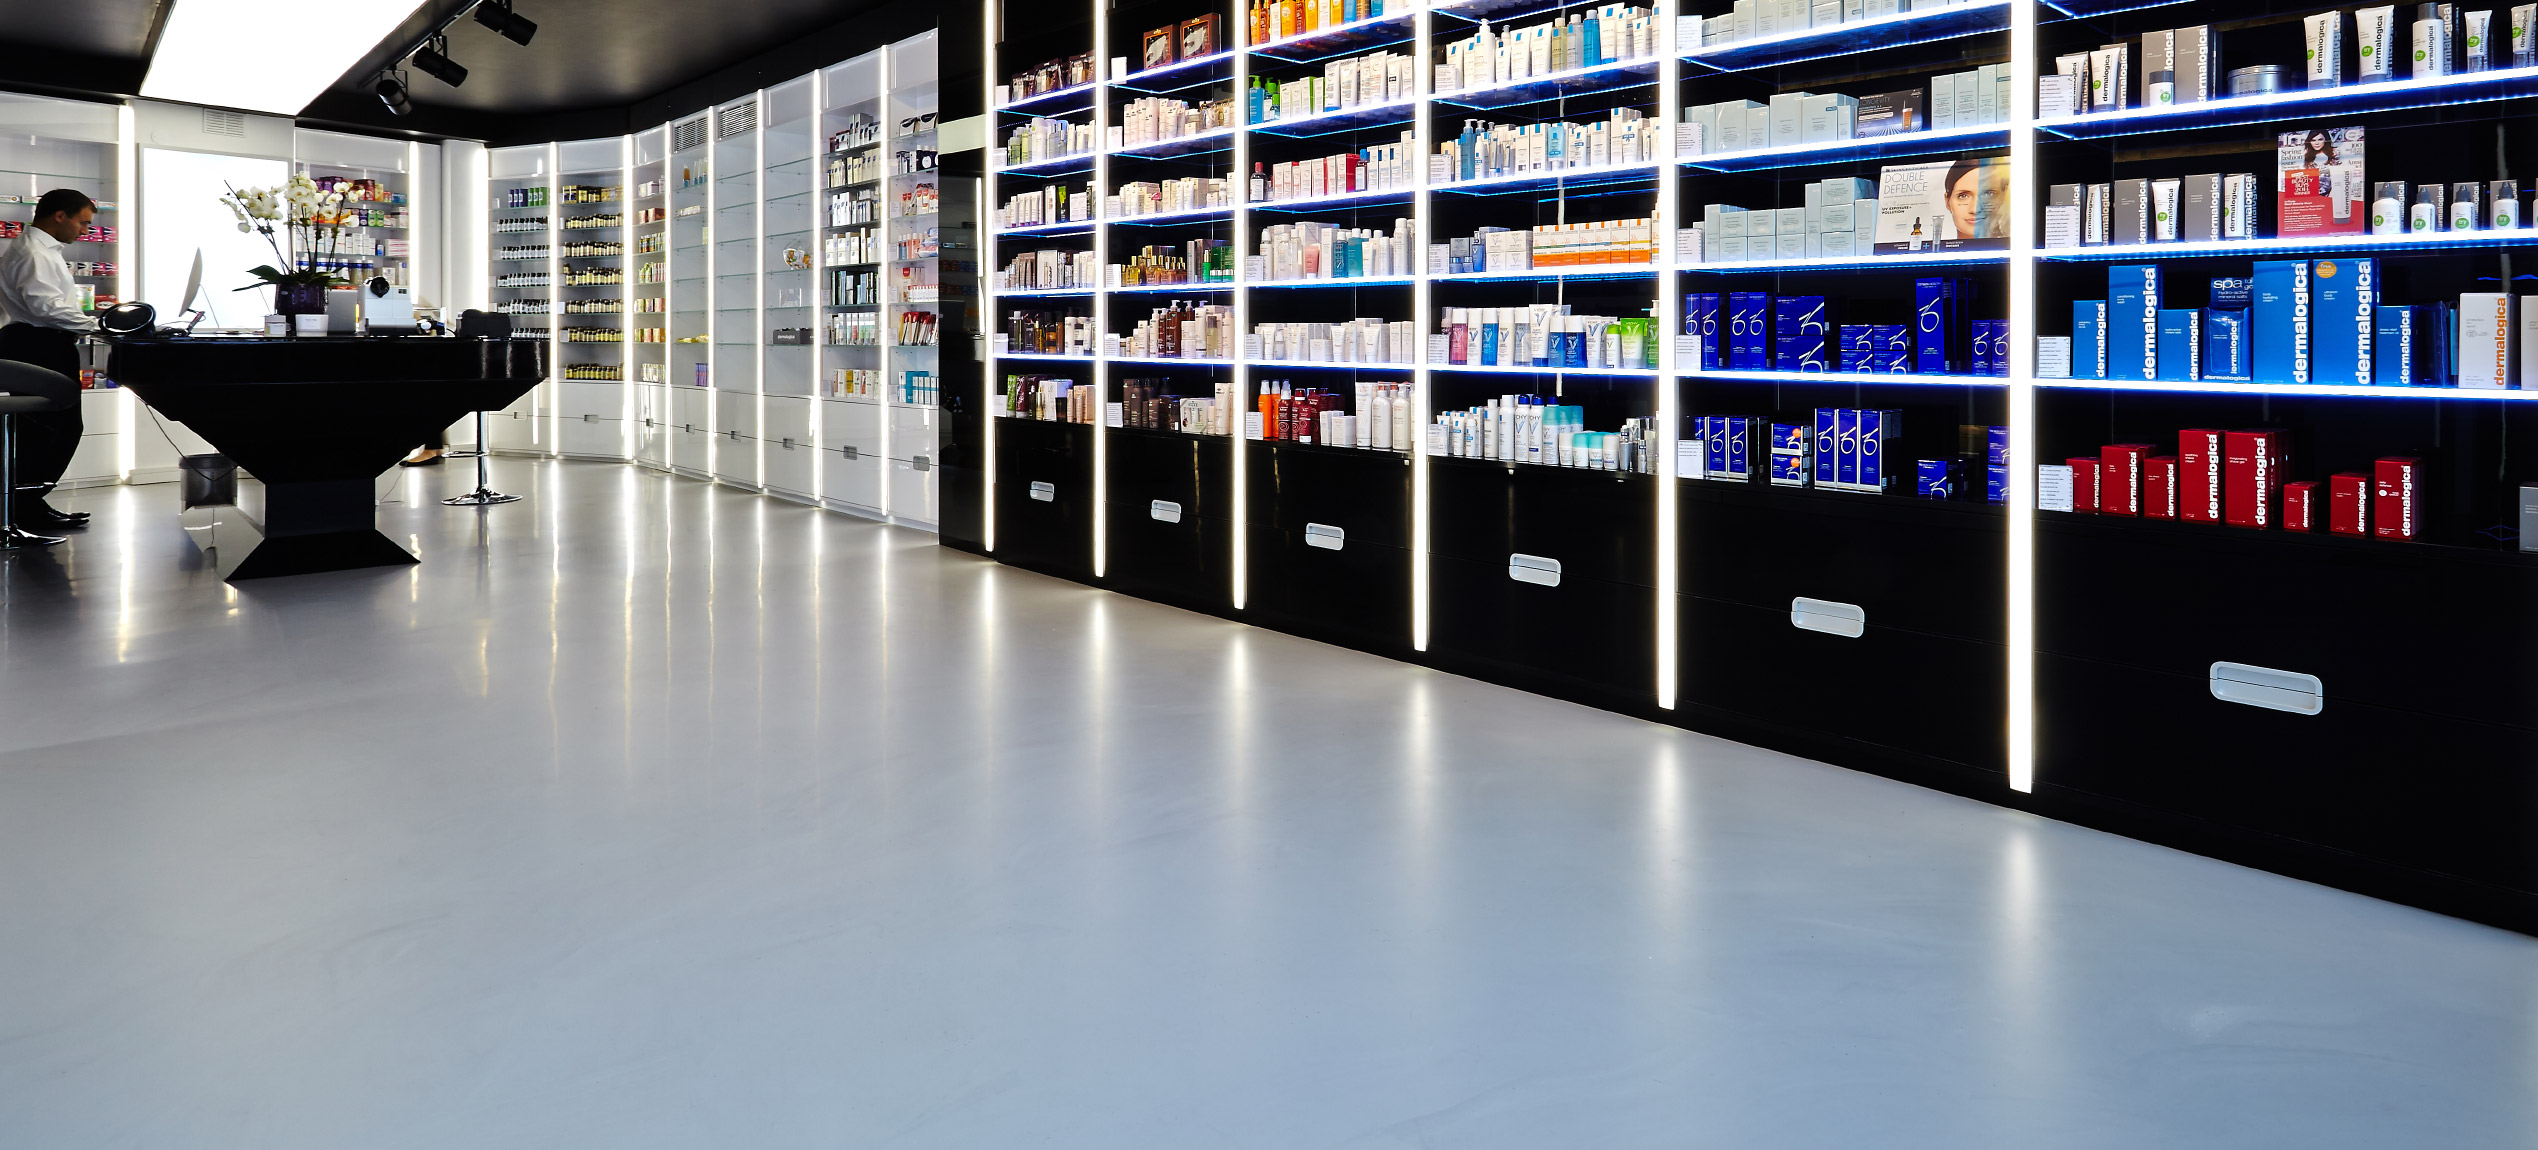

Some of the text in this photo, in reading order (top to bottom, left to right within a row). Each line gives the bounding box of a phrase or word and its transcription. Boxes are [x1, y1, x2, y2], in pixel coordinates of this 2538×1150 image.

[2164, 32, 2175, 71] logica
[2315, 20, 2326, 74] dermalogica
[2375, 15, 2384, 71] dermalogica
[2102, 54, 2111, 102] dermalogica
[1884, 182, 1928, 194] DEFENCE
[1885, 171, 1925, 183] DOUBLE
[2209, 176, 2219, 241] dermalogica
[2229, 182, 2238, 232] dermalogica
[2244, 176, 2253, 240] dermalogica
[2139, 181, 2147, 245] dermalogica
[2213, 279, 2243, 291] spa
[2095, 303, 2107, 378] dermalogica
[2142, 267, 2157, 380] dermalogica
[2189, 311, 2199, 381] dermalogica
[2292, 263, 2309, 383] dermalogica
[2355, 260, 2372, 384] dermalogica
[2399, 310, 2411, 384] dermalogica
[2494, 297, 2508, 386] dermalogica
[2129, 452, 2138, 512] dermalogica
[2167, 464, 2175, 517] dermalogica
[2207, 434, 2219, 519] dermalogica
[2255, 438, 2267, 525] dermalogica
[2358, 482, 2367, 532] dermalogica
[2401, 466, 2412, 536] dermalogica
[2302, 490, 2310, 528] dermalogica
